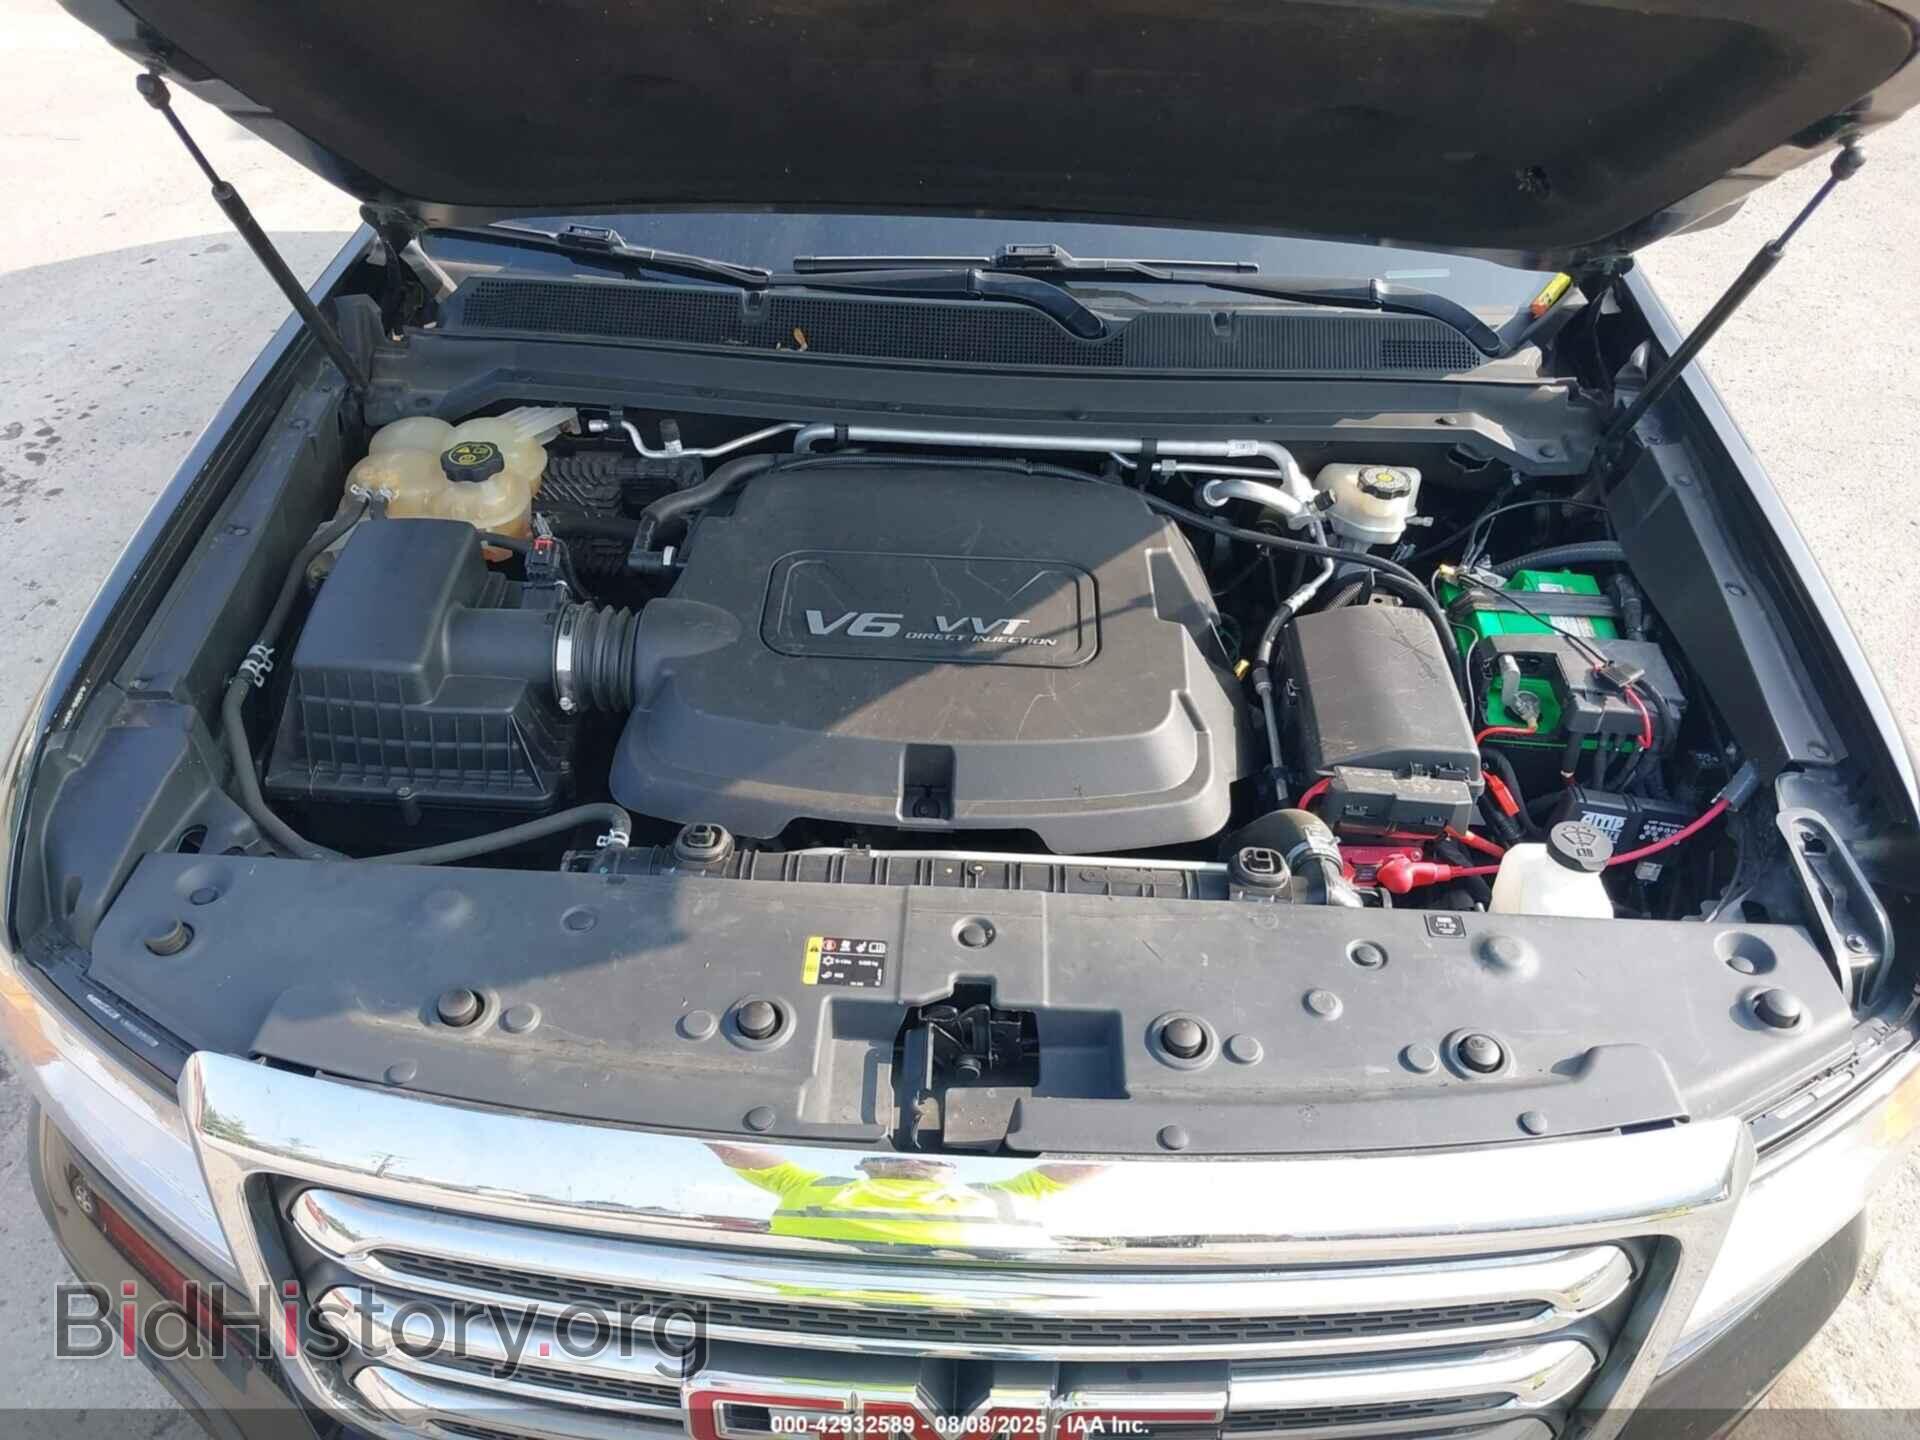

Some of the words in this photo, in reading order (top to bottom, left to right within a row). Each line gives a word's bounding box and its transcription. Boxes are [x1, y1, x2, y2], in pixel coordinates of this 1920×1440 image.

[805, 609, 904, 638] V6
[935, 615, 1030, 634] VVT
[905, 632, 965, 641] DIRECT
[972, 635, 1057, 647] INJECTION
